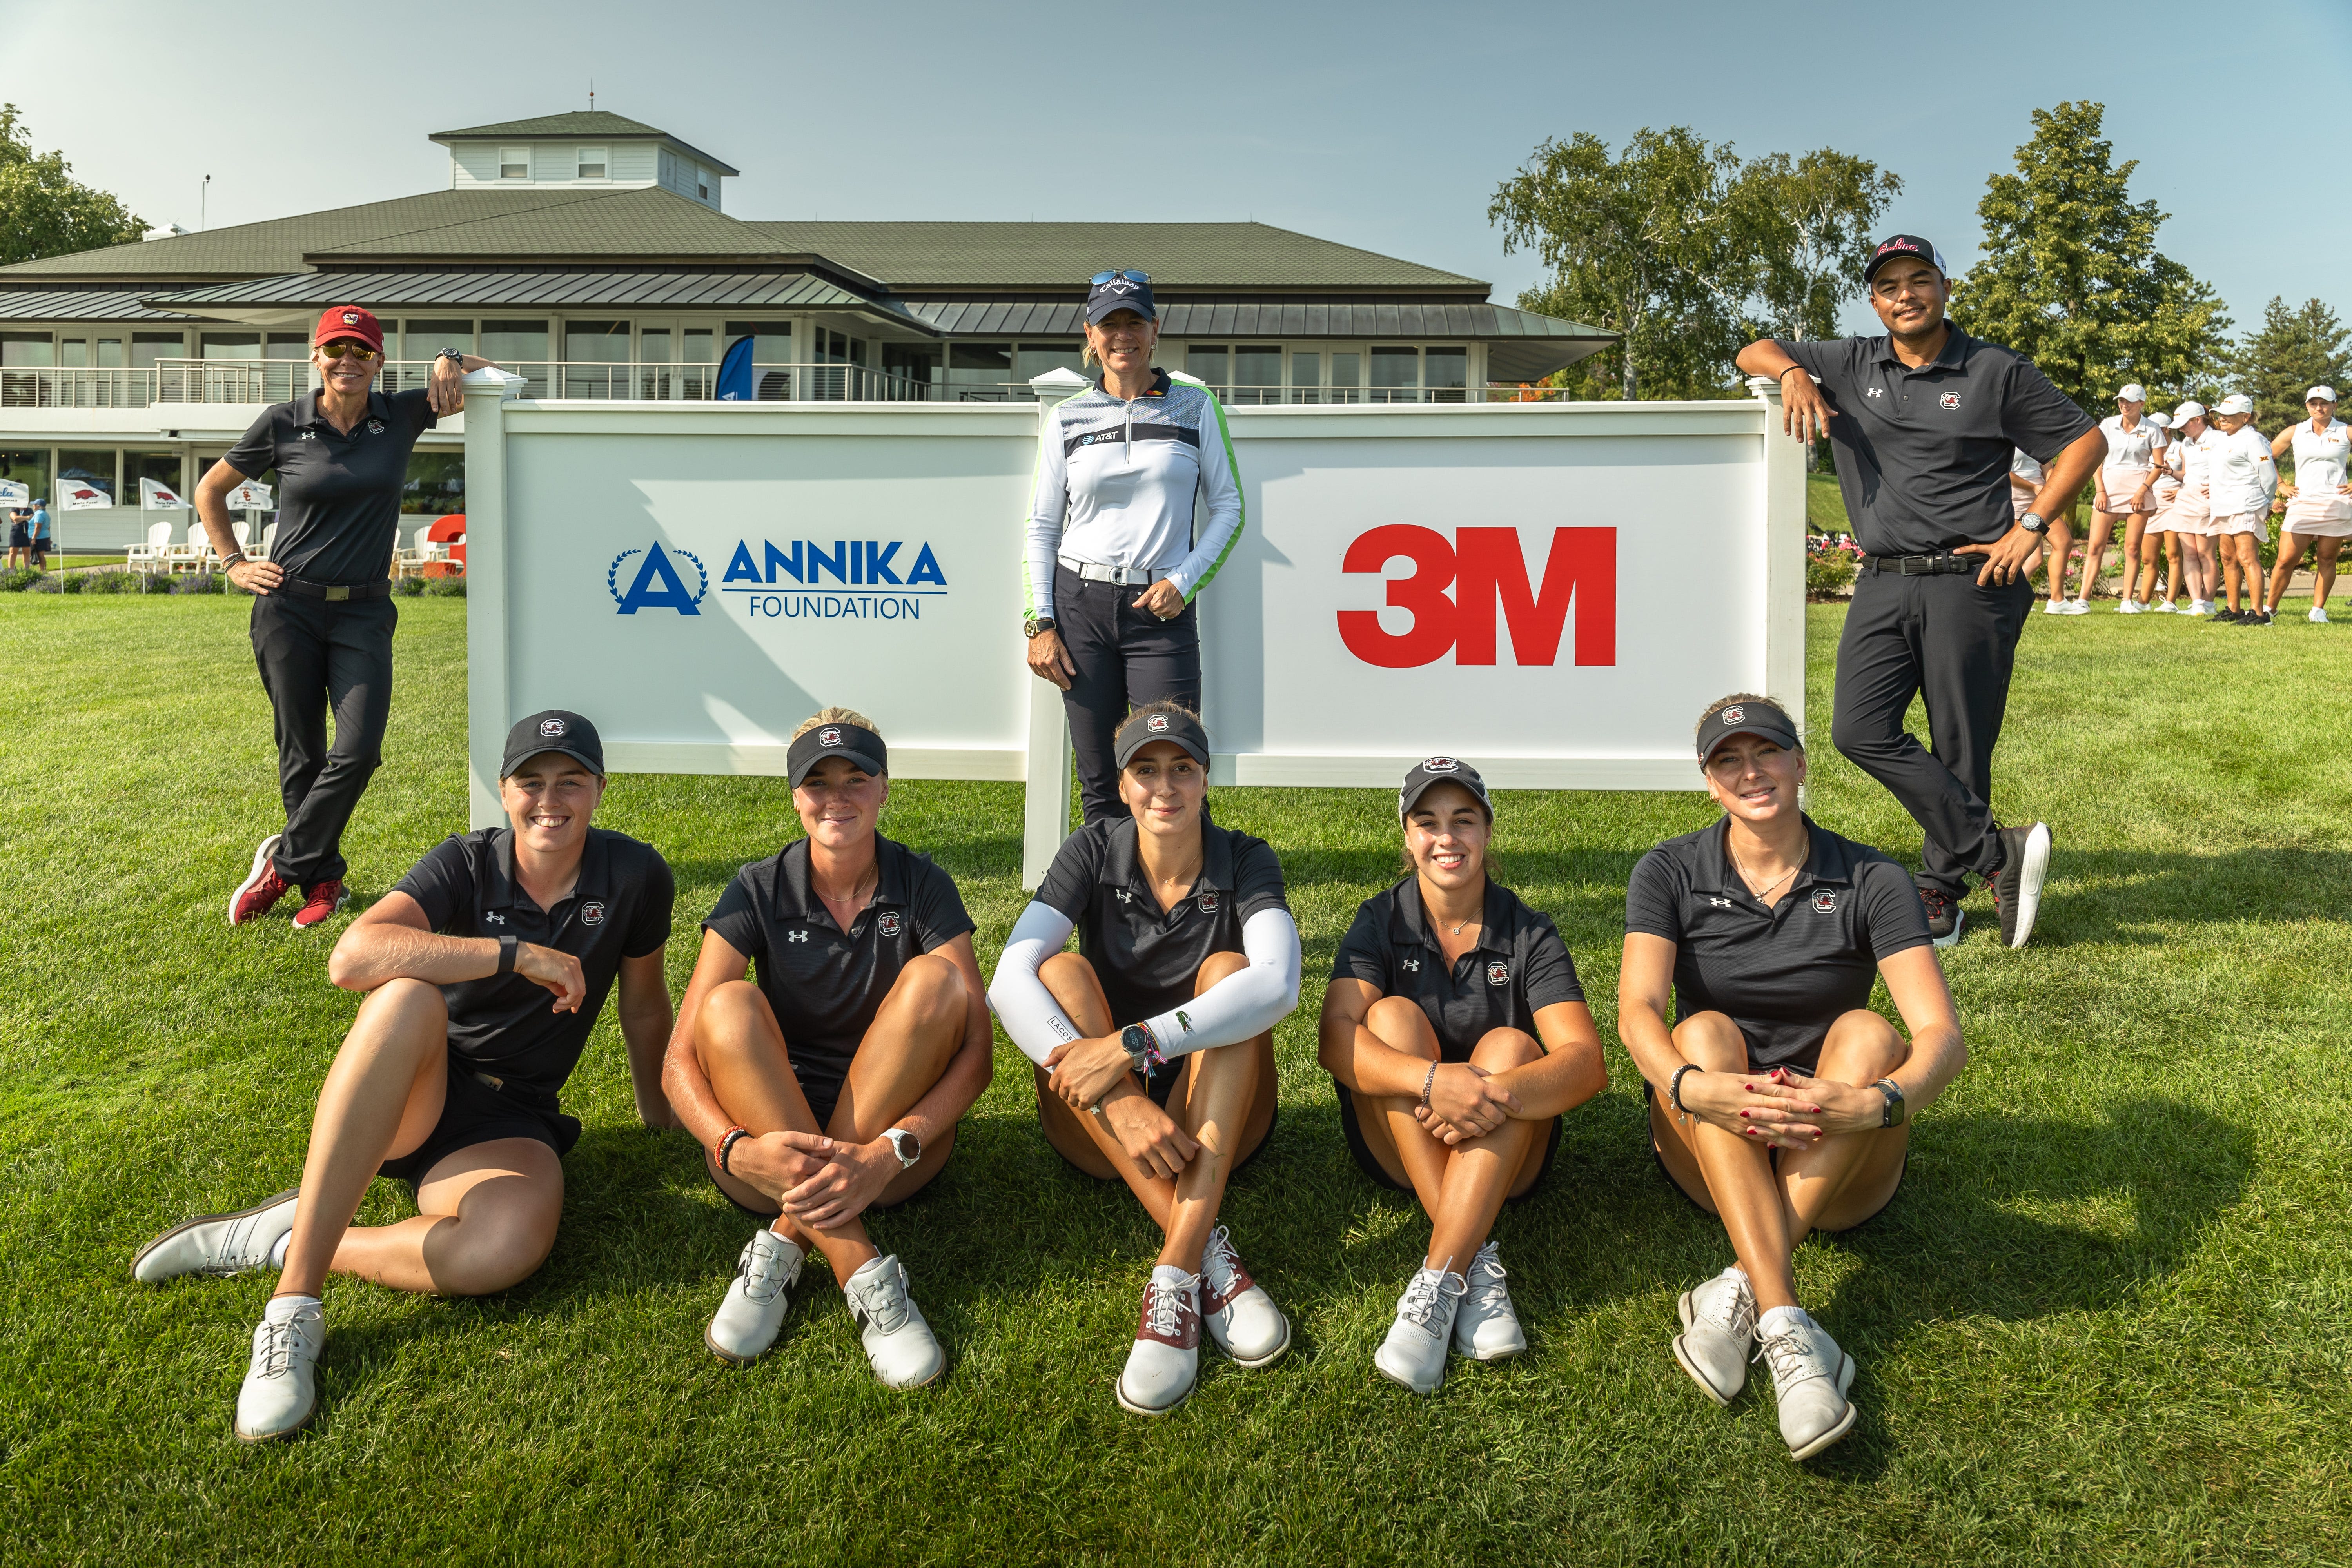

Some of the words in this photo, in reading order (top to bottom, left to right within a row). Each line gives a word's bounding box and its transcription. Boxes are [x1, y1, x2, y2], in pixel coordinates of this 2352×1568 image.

[1877, 238, 1919, 257] Carolina
[1099, 279, 1139, 293] Callaway
[1094, 431, 1118, 442] AT&T
[722, 539, 947, 585] ANNIKA
[1337, 524, 1617, 668] 3M
[750, 596, 920, 619] FOUNDATION
